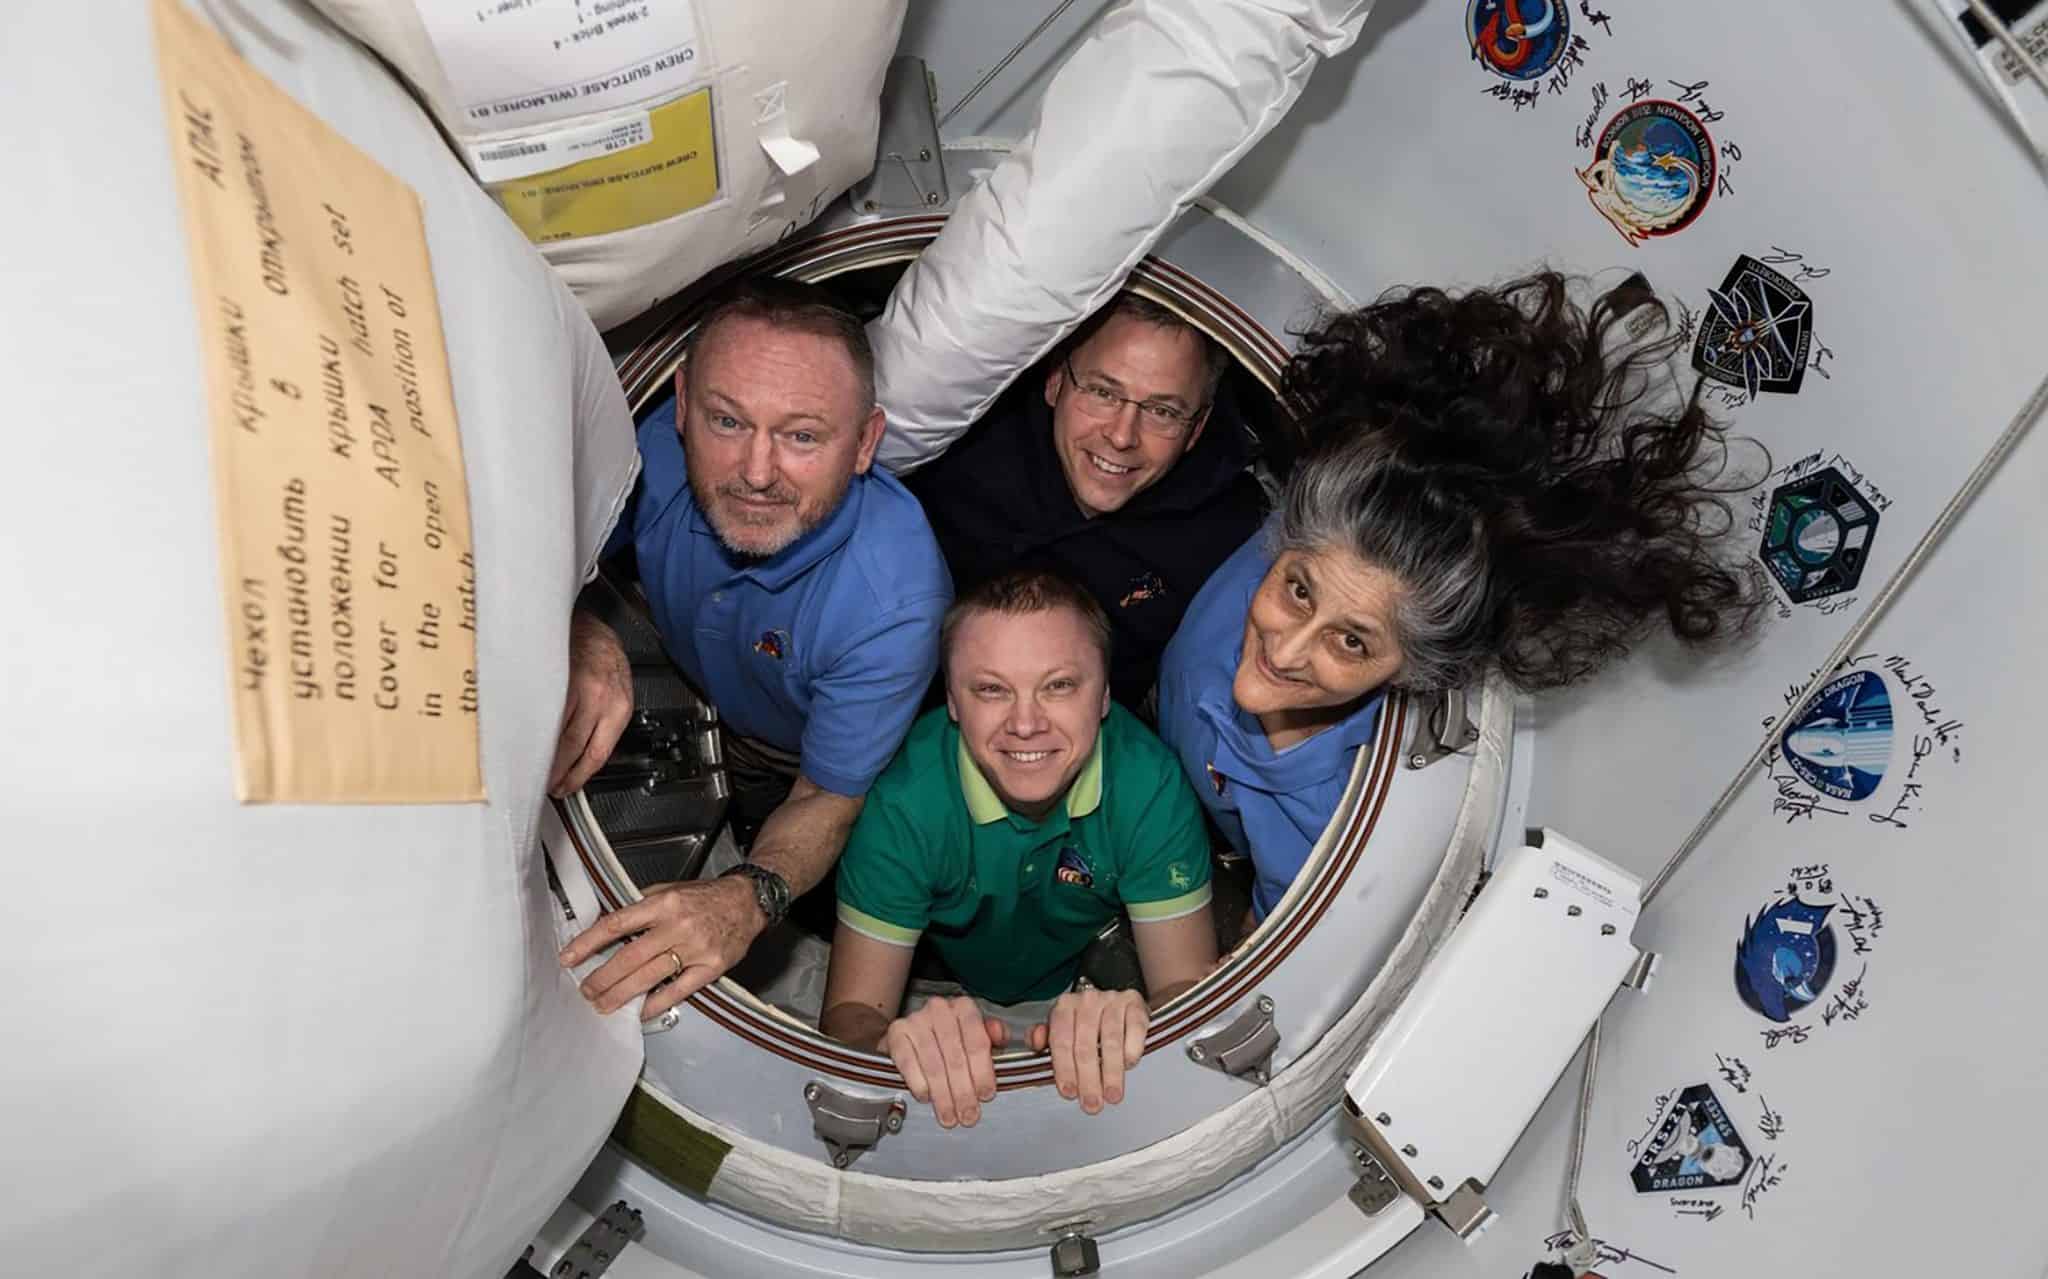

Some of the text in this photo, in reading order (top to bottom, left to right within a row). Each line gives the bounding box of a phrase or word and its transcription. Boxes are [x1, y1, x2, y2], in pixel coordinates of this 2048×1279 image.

[470, 48, 695, 120] CREW SUITCASE (WILMORE) B1
[179, 88, 226, 191] АПАС
[322, 202, 354, 256] set
[336, 275, 375, 358] hatch
[318, 333, 358, 701] положении крышки
[378, 283, 448, 718] in the open position of
[277, 477, 324, 700] установить
[373, 542, 400, 590] for
[373, 619, 399, 711] Cover
[458, 551, 479, 716] the hatch
[1823, 672, 1865, 697] DRAGON
[1652, 1175, 1704, 1189] DRAGON
